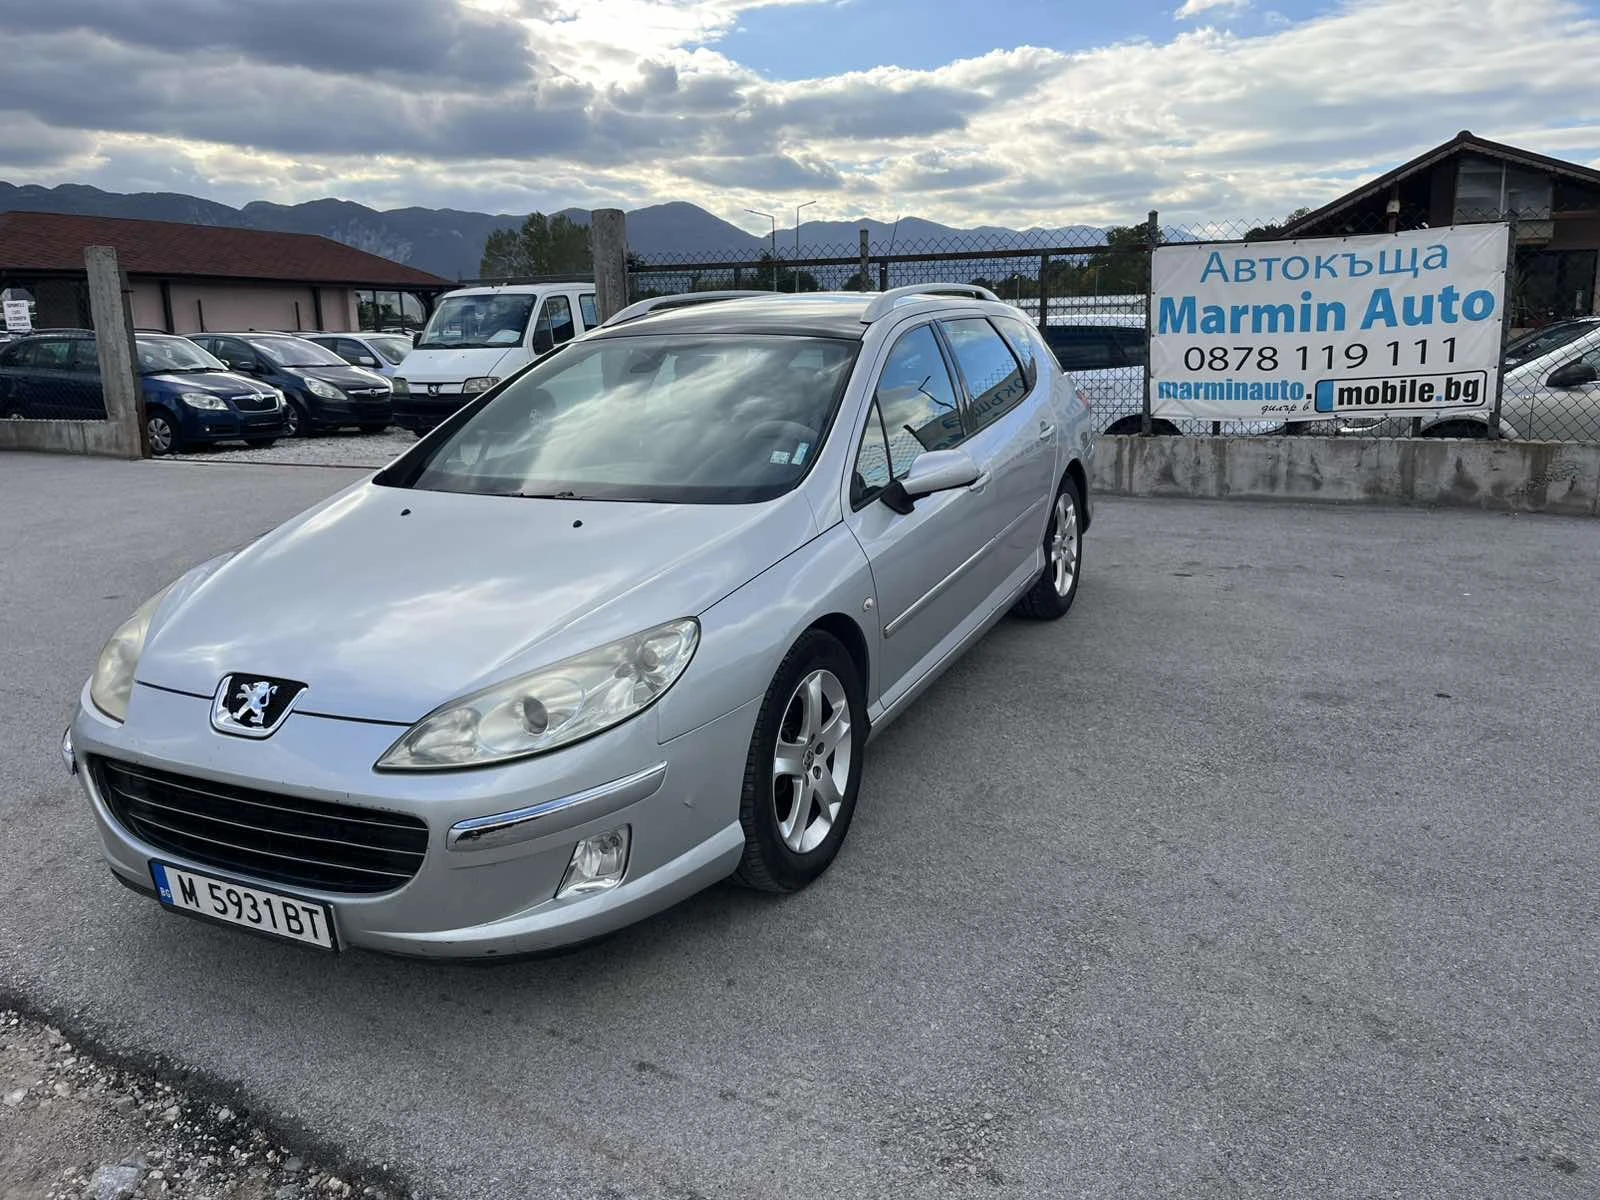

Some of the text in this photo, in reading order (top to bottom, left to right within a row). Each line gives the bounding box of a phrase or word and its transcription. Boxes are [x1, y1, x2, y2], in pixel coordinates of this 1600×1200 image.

[1199, 244, 1449, 284] Автокъща
[1158, 285, 1496, 336] Marmin Auto
[1184, 337, 1457, 372] 0878 119 111
[1338, 376, 1480, 406] mobile.bg
